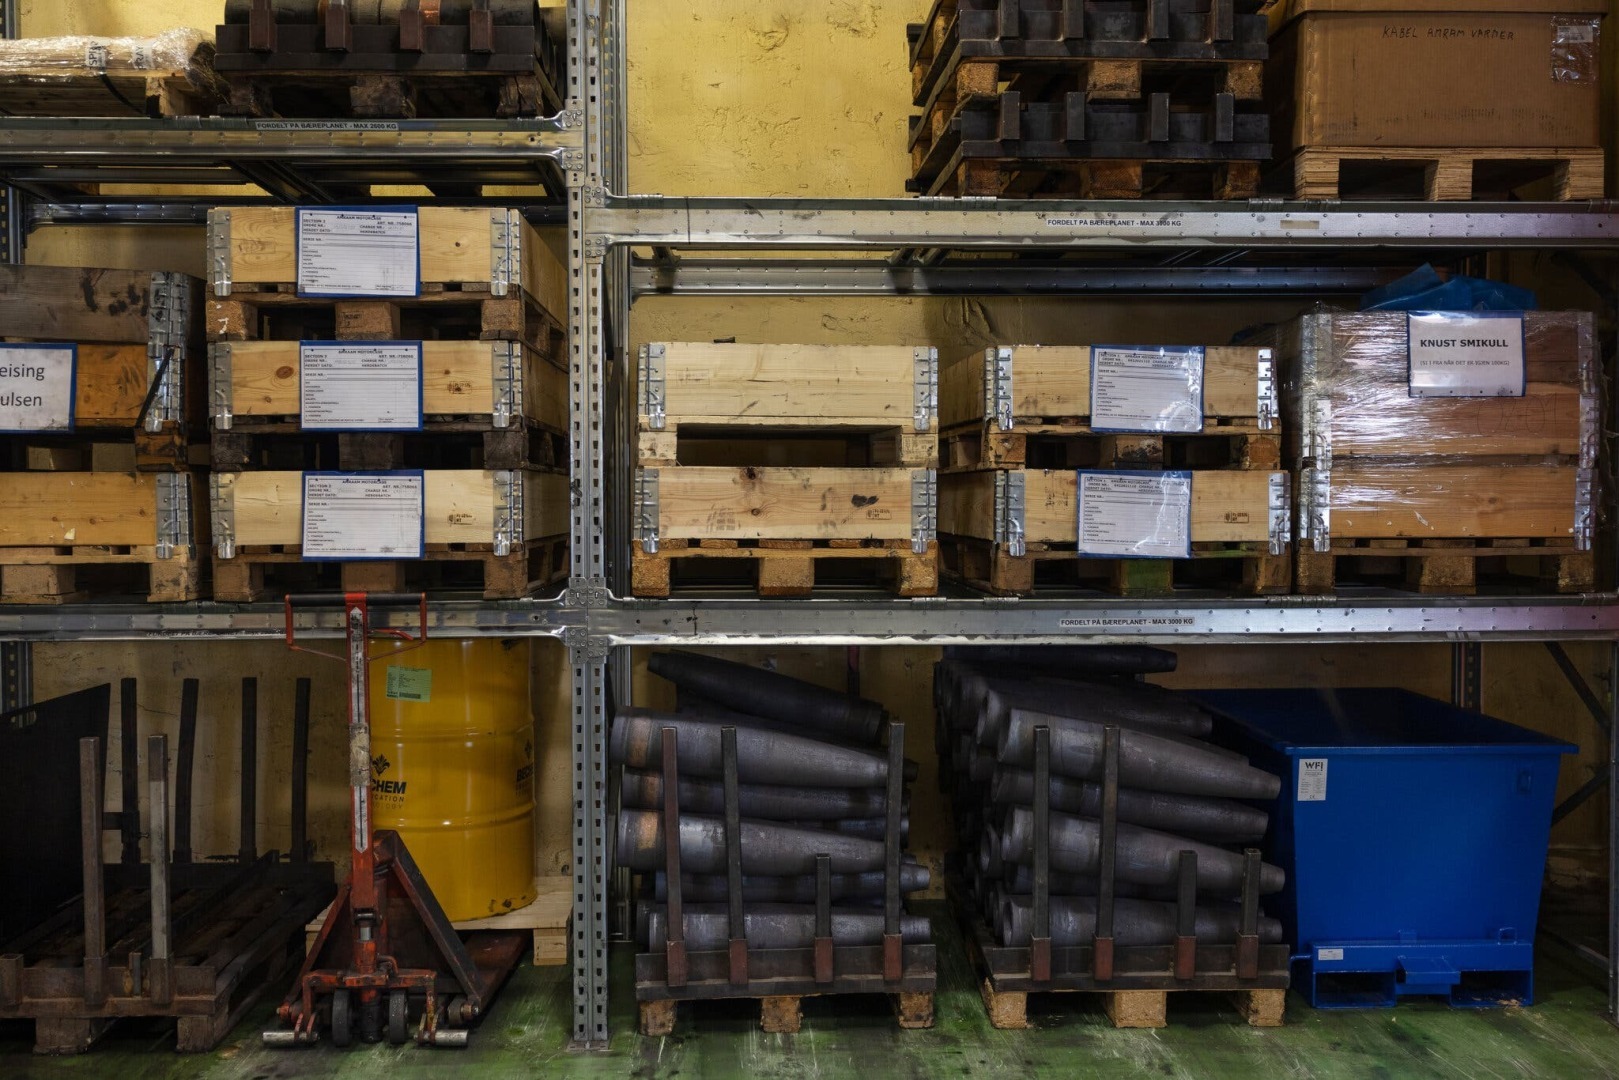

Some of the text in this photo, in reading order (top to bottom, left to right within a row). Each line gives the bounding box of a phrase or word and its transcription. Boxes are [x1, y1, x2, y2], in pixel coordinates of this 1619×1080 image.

[1382, 25, 1417, 39] KABEL
[0, 364, 45, 382] eising
[0, 392, 42, 406] ulsen
